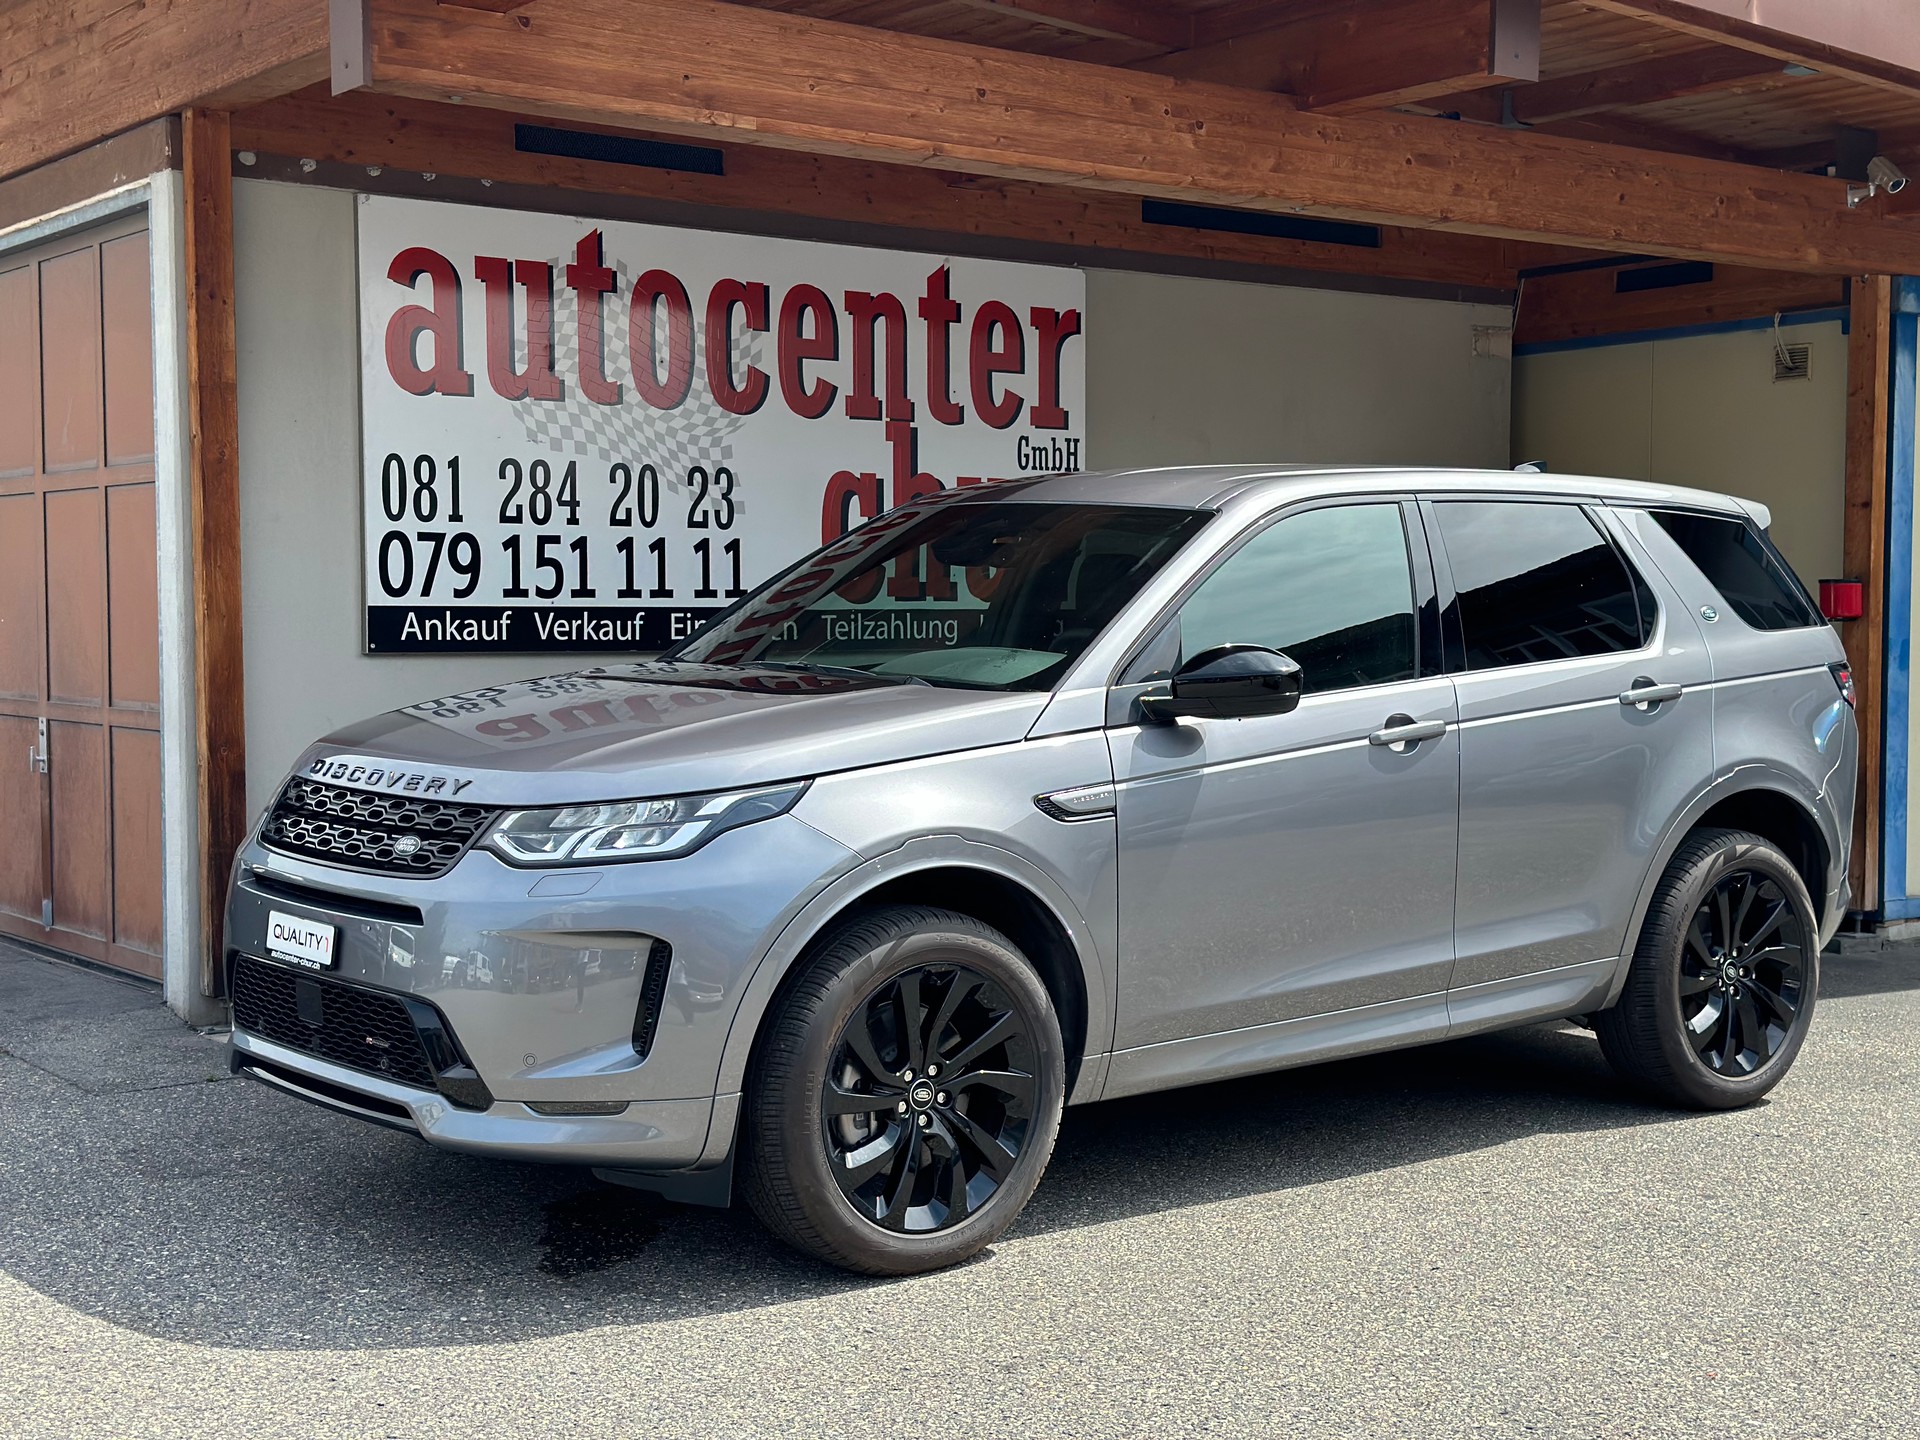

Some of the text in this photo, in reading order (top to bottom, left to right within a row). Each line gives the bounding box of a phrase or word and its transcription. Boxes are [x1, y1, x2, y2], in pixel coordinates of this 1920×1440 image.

[385, 228, 1082, 432] autocenter
[1017, 435, 1081, 473] GmbH
[381, 453, 736, 531] 081 284 20 23
[378, 530, 749, 600] 079 151 11 11
[400, 610, 512, 641] Ankauf
[533, 611, 645, 641] Verkauf
[821, 612, 958, 646] Teilzahlung
[309, 758, 473, 796] DISCOVERY
[273, 923, 324, 951] QUALITY
[271, 950, 321, 970] autocenter-chur.ch
